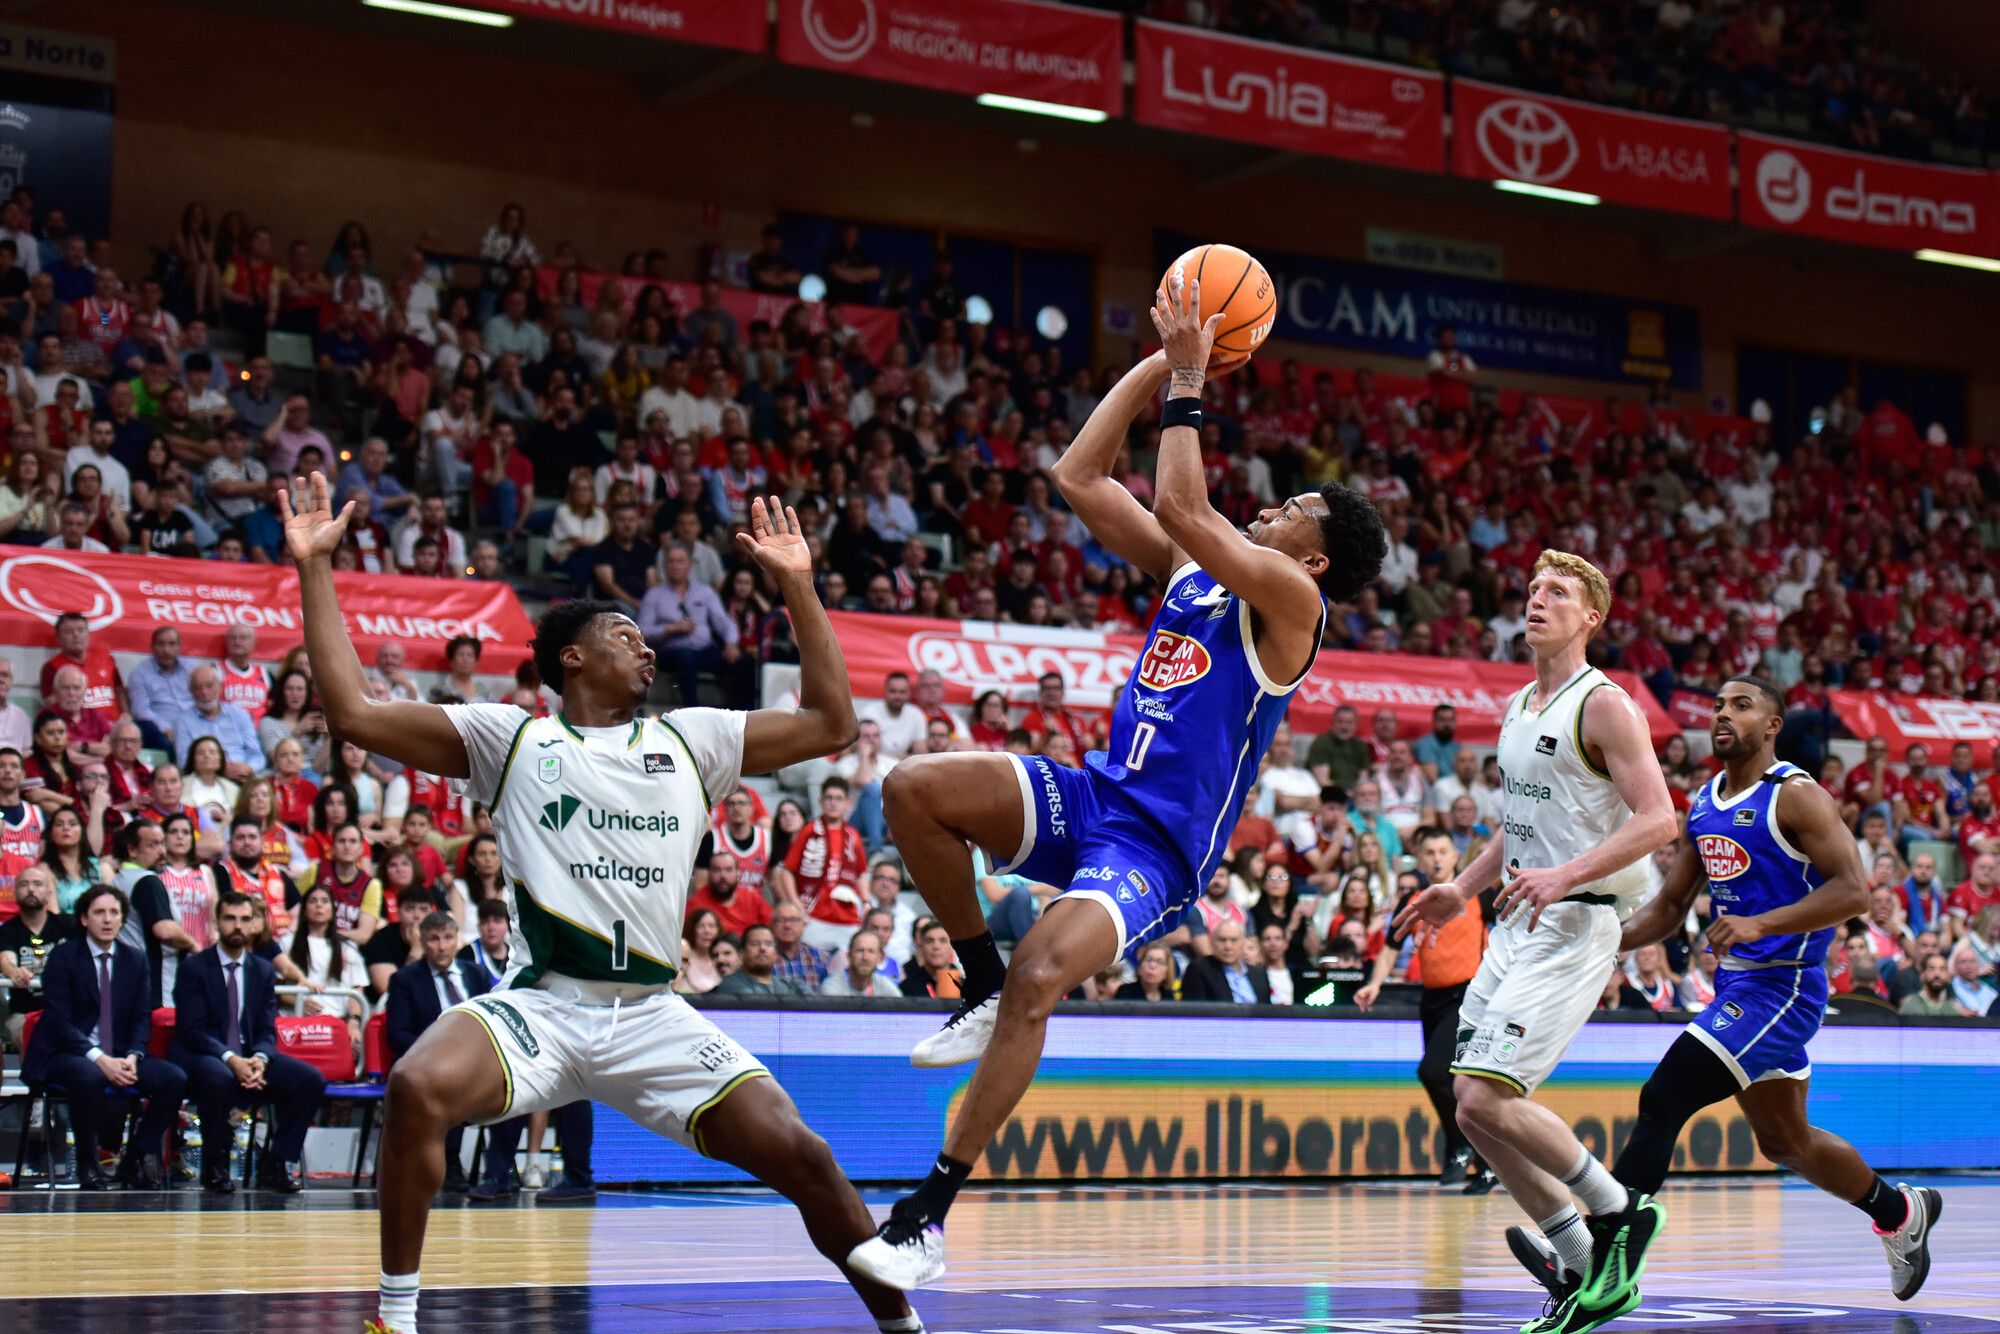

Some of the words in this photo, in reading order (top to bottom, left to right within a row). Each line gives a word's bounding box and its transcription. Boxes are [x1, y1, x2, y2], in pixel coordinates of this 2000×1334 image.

[26, 37, 106, 70] Norte
[1600, 140, 1711, 186] LABASA
[1824, 167, 1977, 235] dama
[147, 598, 295, 630] REGIÓN
[357, 613, 503, 642] MURCIA
[1338, 680, 1500, 713] ESTRELLA
[1126, 721, 1156, 771] 0
[1506, 777, 1552, 803] Unicaja
[588, 808, 680, 837] Unicaja
[1504, 814, 1535, 841] álaga
[611, 918, 629, 971] 1
